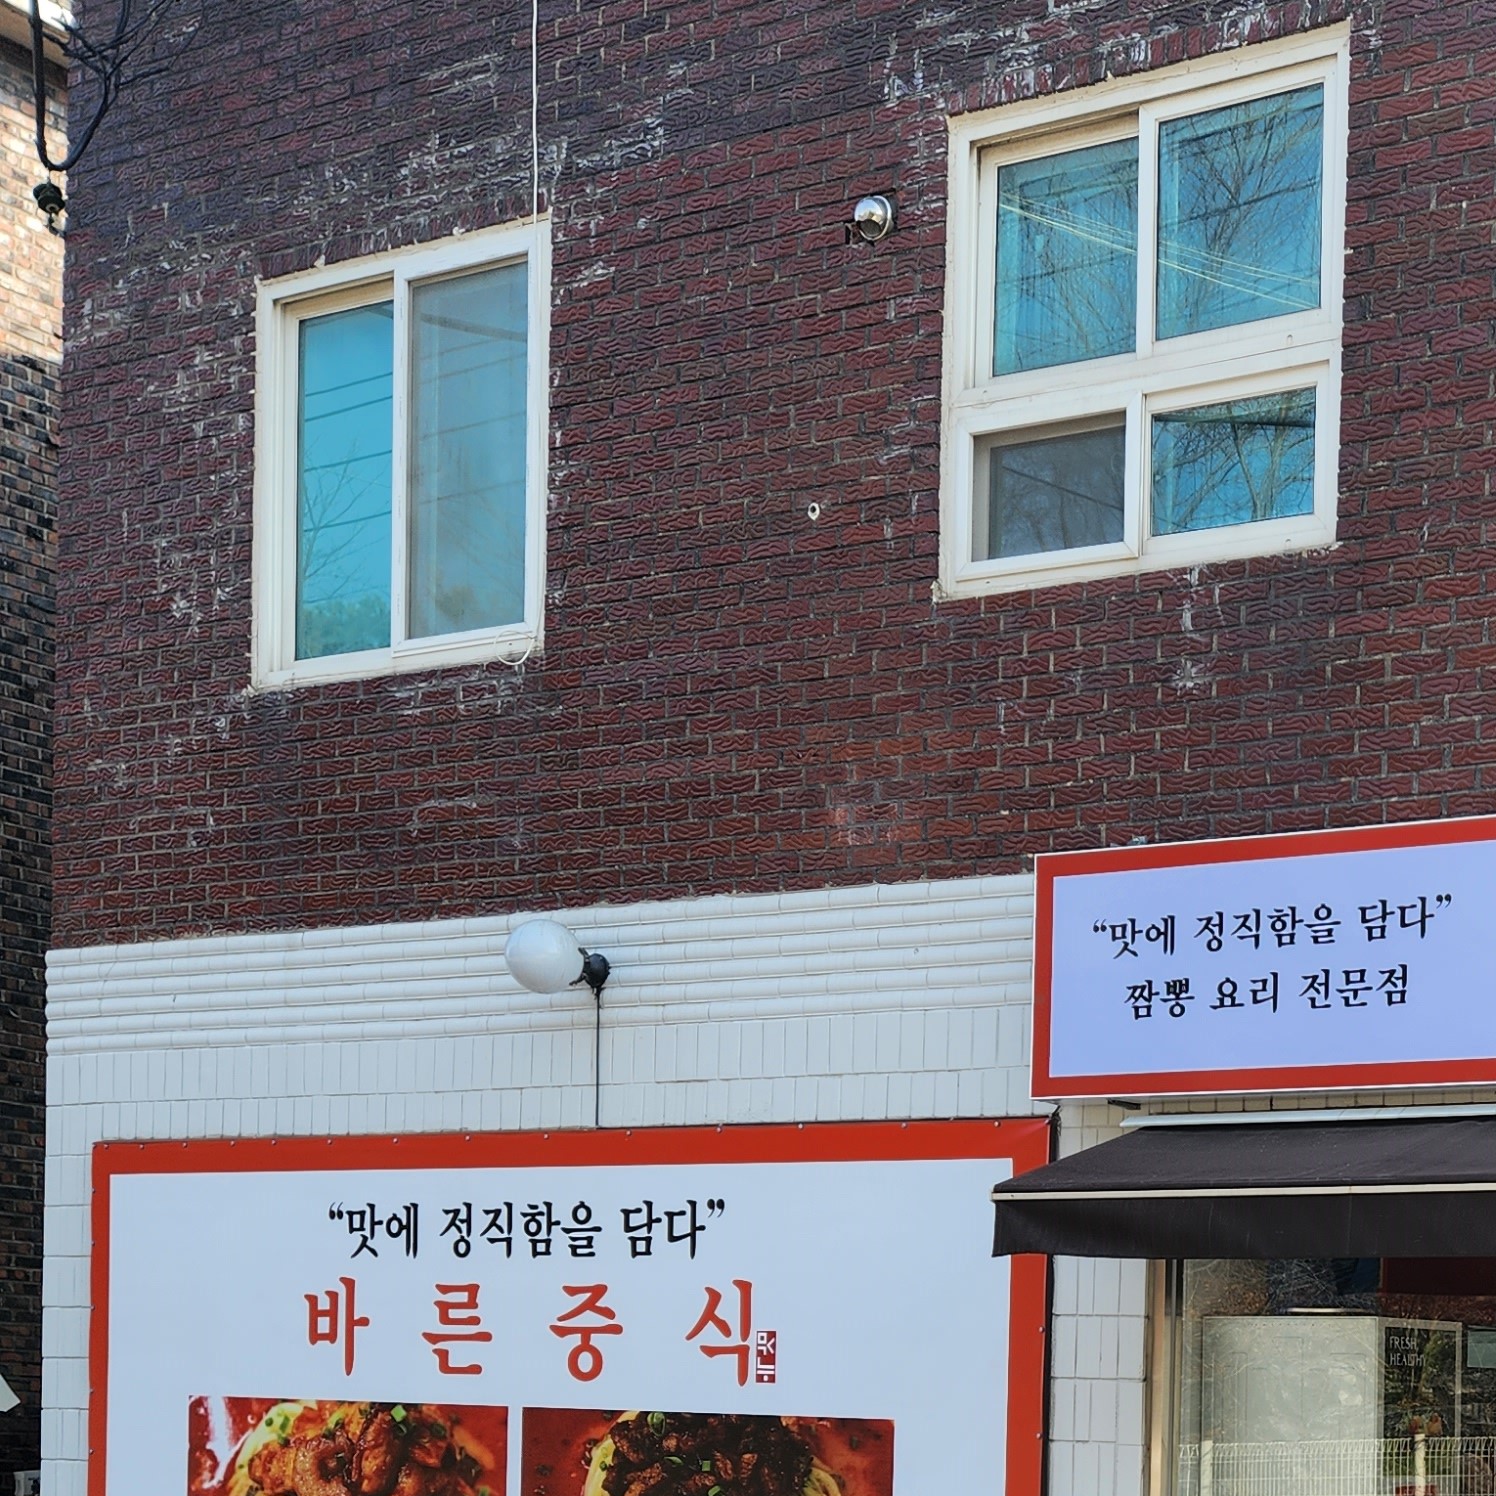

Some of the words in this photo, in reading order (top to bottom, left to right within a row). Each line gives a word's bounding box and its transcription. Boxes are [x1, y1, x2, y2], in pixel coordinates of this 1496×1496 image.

[1193, 902, 1342, 952] 정직함을
[1123, 977, 1196, 1020] 짬뽕
[1208, 971, 1280, 1014] 요리
[1298, 963, 1409, 1010] 전문점
[439, 1200, 603, 1260] 정직함을
